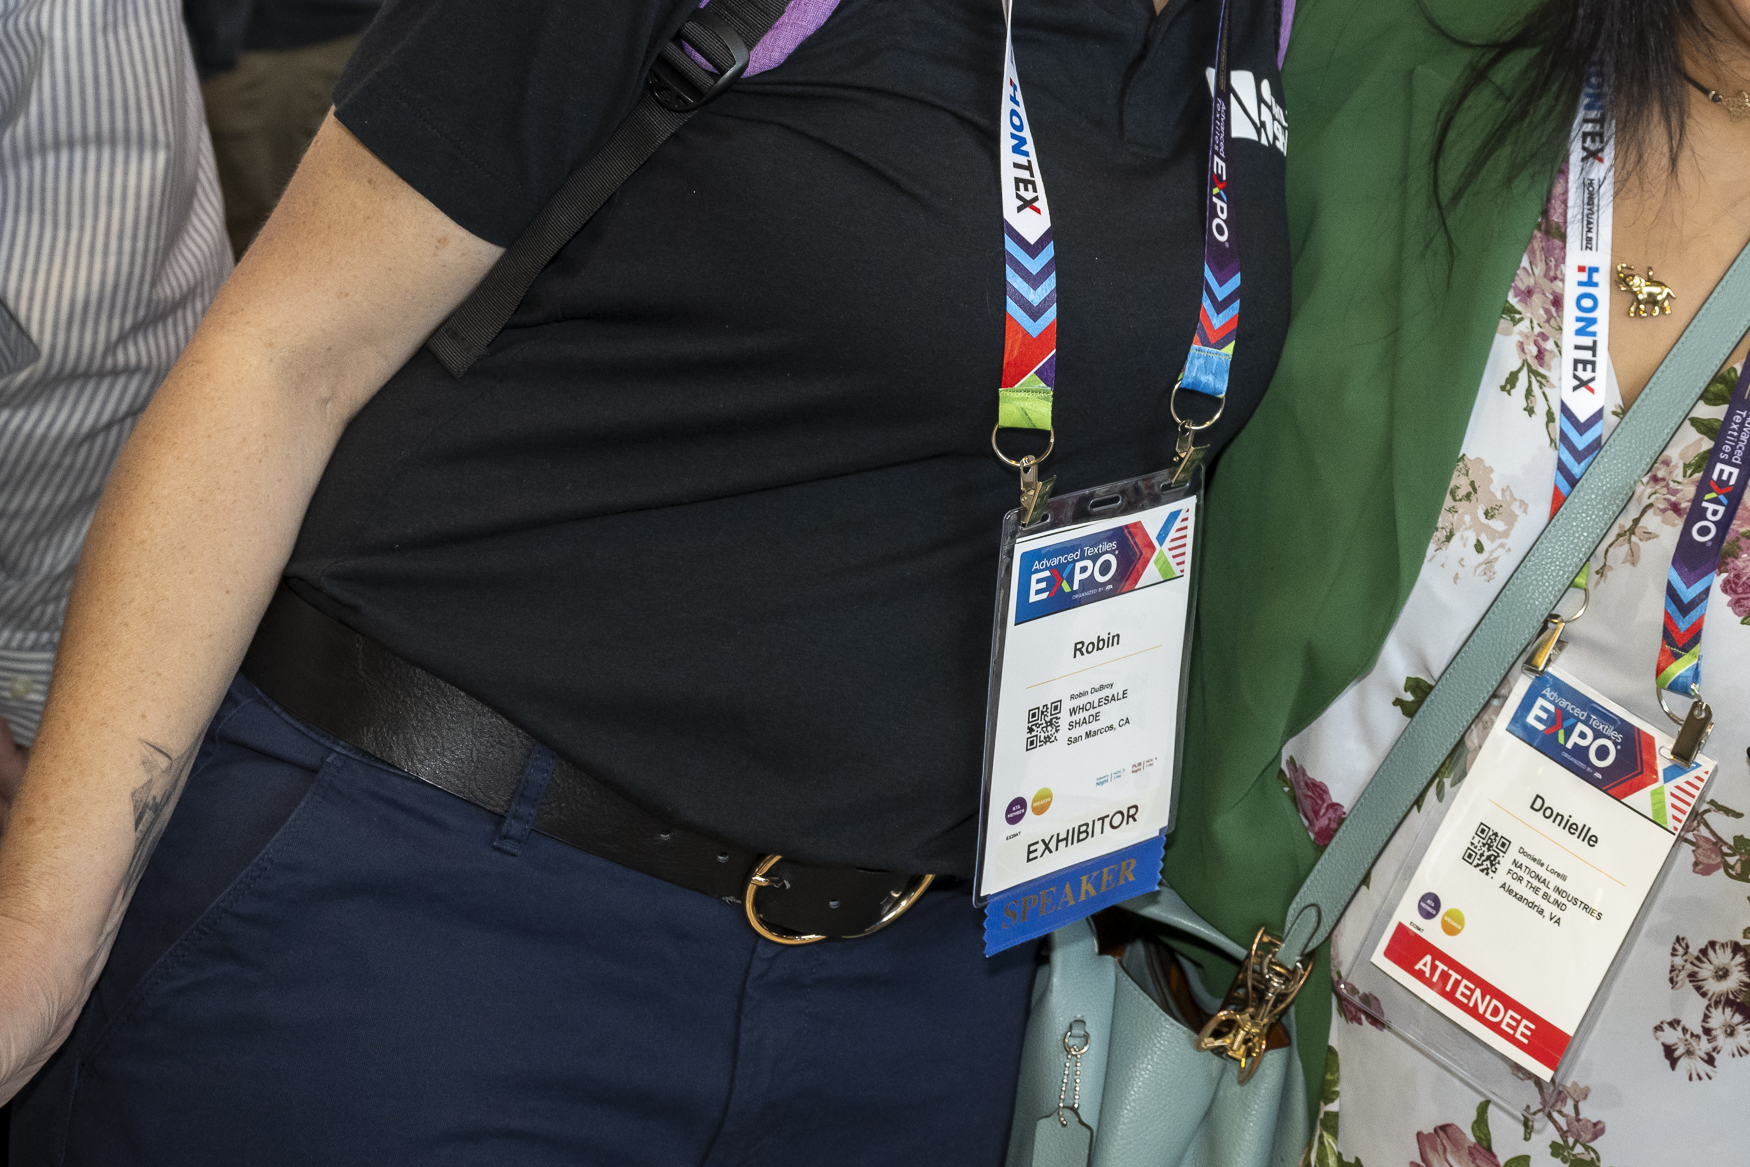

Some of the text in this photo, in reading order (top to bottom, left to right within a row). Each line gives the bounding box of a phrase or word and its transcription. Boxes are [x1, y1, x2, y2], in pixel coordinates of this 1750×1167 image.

[1010, 77, 1042, 215] HONTEX
[1213, 97, 1221, 151] Textiles
[1219, 100, 1227, 158] Advanced
[1585, 178, 1595, 251] HONGYUAN.BIZ
[1572, 265, 1600, 396] HONTEX
[1719, 409, 1747, 460] Textiles
[1031, 541, 1117, 572] Advanced Textiles
[1073, 632, 1121, 659] Robin
[1069, 689, 1129, 717] WHOLESALE
[1070, 682, 1114, 701] Robin DuBroy
[1541, 687, 1624, 743] Advanced Textiles
[1067, 716, 1130, 746] San Marcos, CA
[1068, 711, 1101, 731] SHADE
[1026, 804, 1139, 863] EXHIBITOR
[1529, 793, 1599, 848] Donielle
[1518, 846, 1545, 868] Donielle
[1001, 858, 1137, 929] SPEAKER
[1499, 881, 1562, 927] Alexandria, VA
[1506, 868, 1568, 912] FOR THE BLIND
[1511, 858, 1603, 921] NATIONAL INDUSTRIES
[1414, 954, 1536, 1045] ATTENDEE
